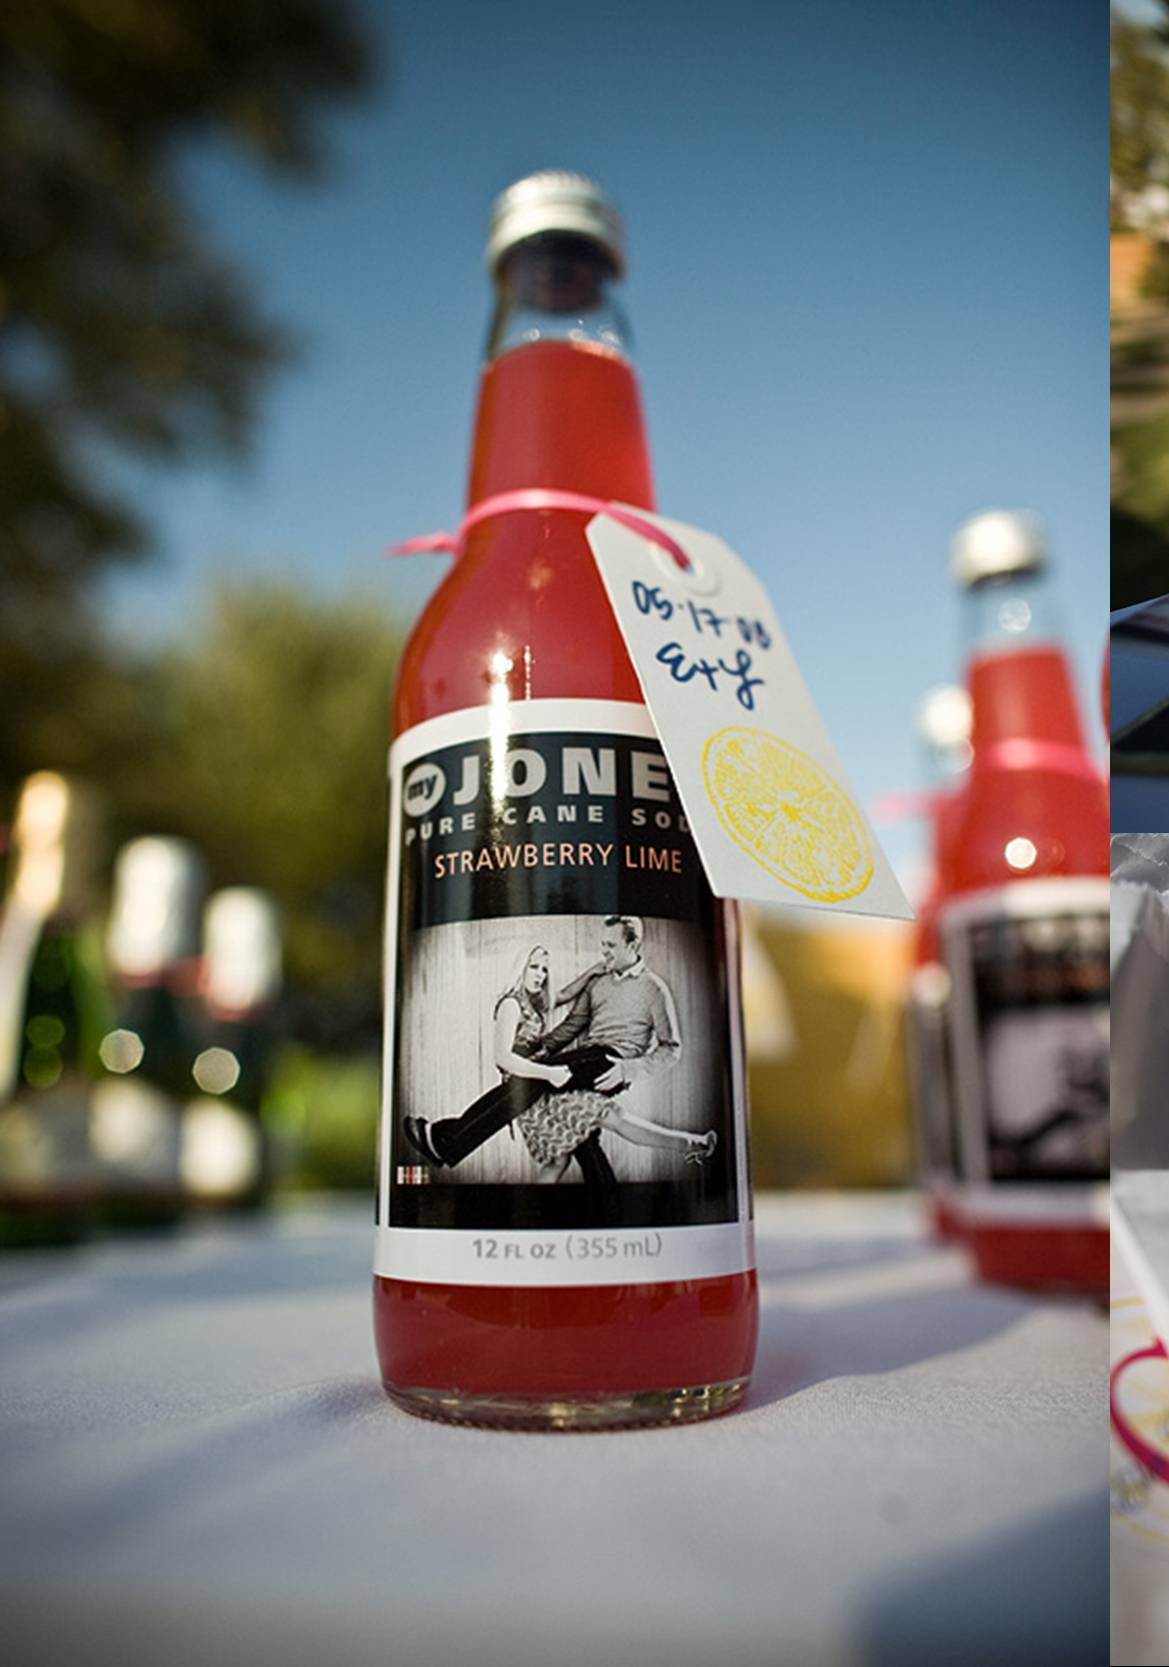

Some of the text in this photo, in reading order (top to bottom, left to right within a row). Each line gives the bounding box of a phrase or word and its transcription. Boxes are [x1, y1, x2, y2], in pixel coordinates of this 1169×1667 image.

[453, 747, 672, 806] JONE
[405, 805, 692, 847] PURE CANE SOD
[435, 843, 683, 879] STRAWBERRY LIME
[472, 1239, 498, 1260] 12
[566, 1234, 617, 1260] (355
[623, 1233, 663, 1259] mL)
